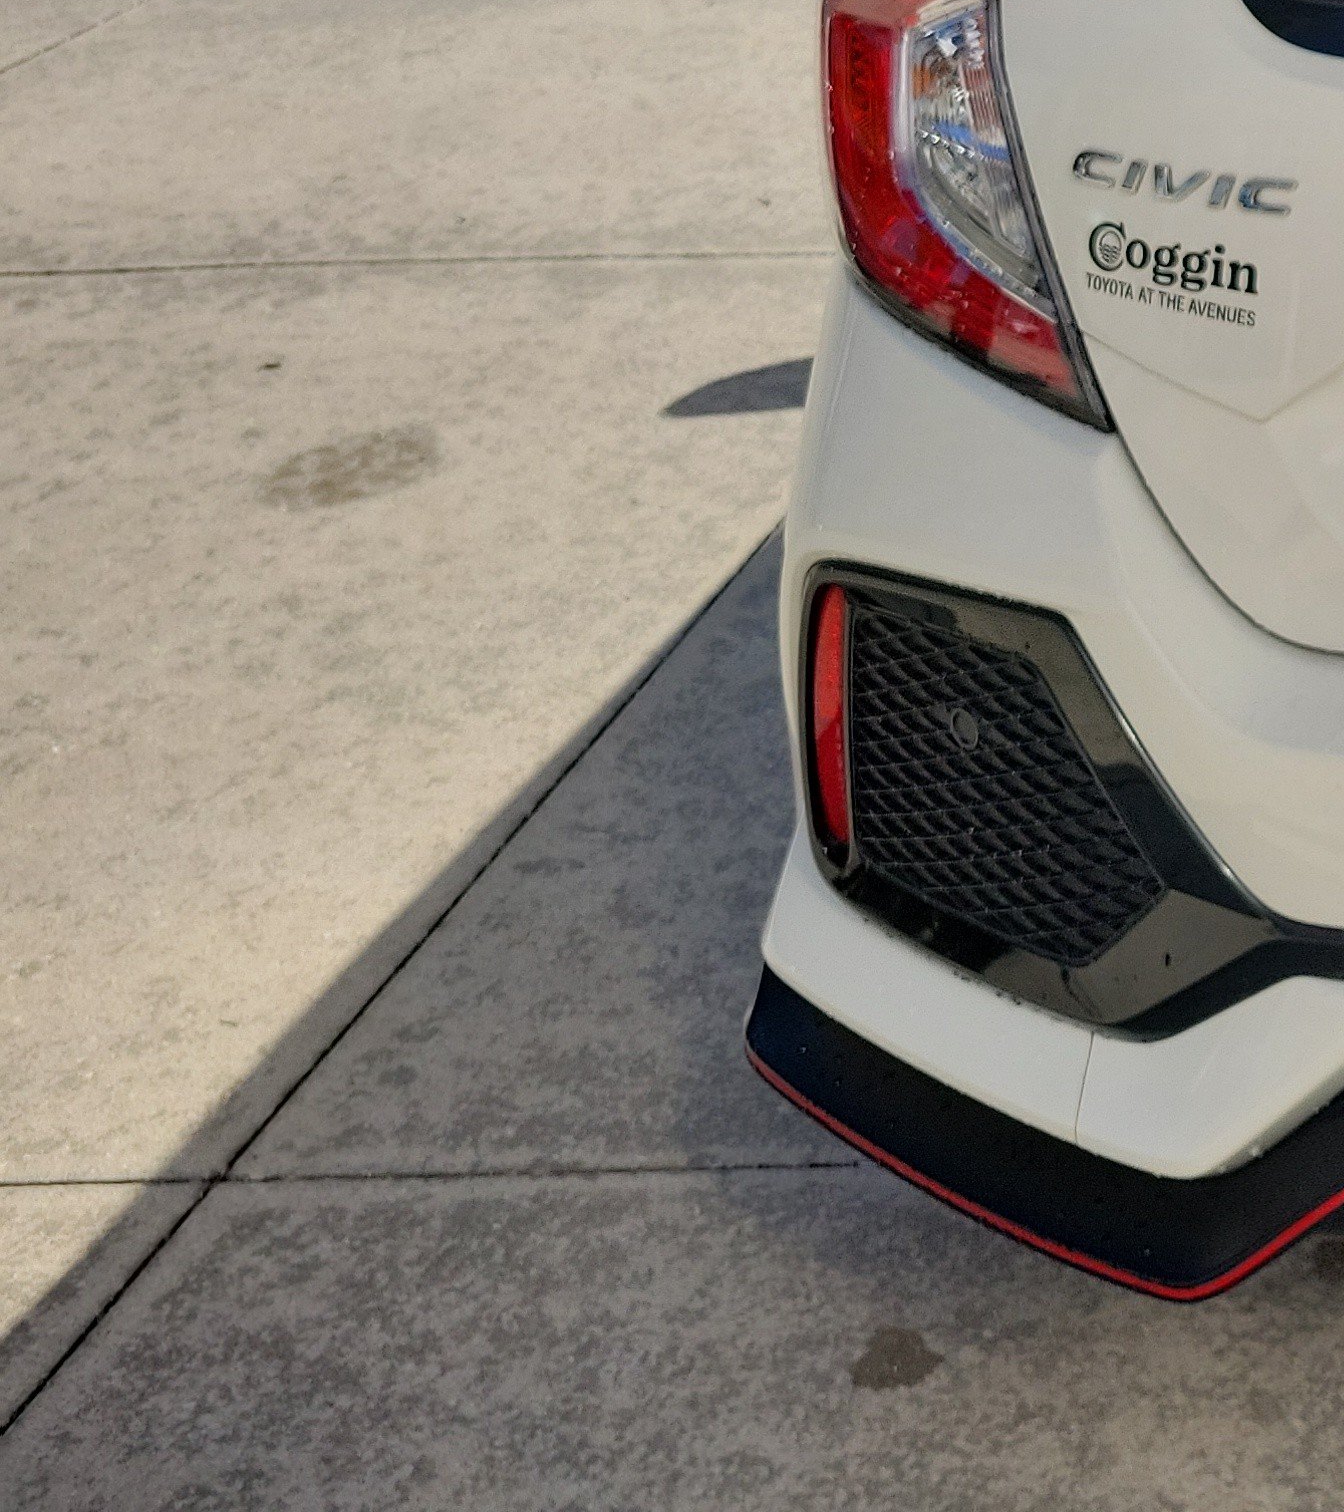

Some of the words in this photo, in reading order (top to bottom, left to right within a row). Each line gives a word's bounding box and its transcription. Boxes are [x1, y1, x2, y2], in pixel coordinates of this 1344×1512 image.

[1073, 150, 1299, 216] CIVIC
[1088, 222, 1259, 295] Coggin
[1086, 272, 1133, 300] TOYOTA
[1138, 287, 1154, 305] AT
[1158, 290, 1185, 312] THE
[1188, 299, 1257, 327] AVENUES
